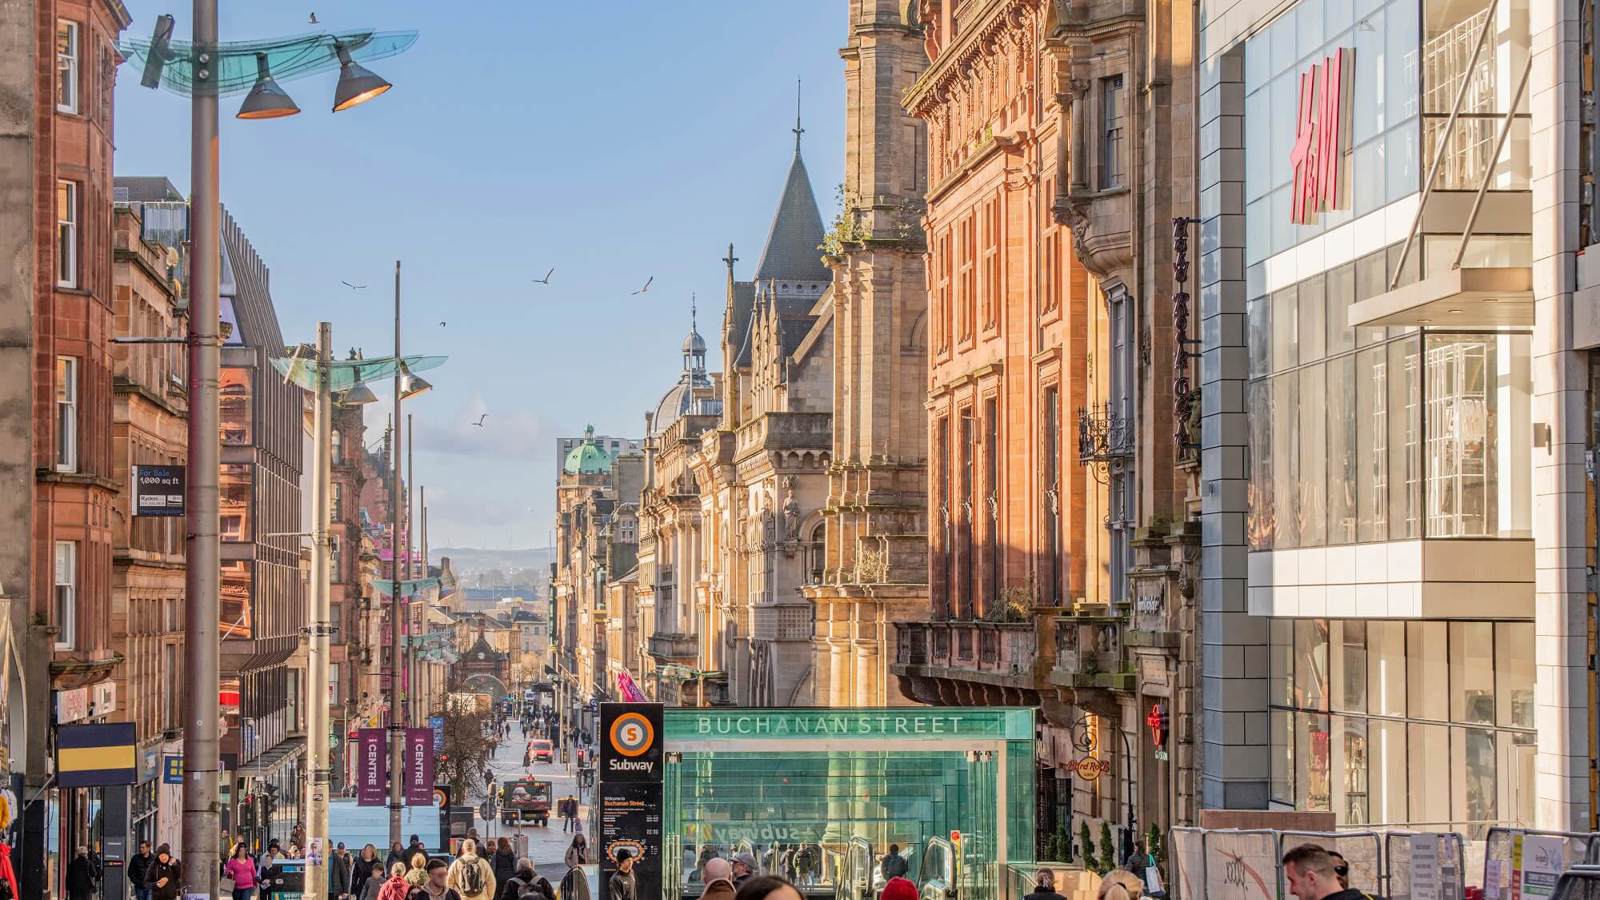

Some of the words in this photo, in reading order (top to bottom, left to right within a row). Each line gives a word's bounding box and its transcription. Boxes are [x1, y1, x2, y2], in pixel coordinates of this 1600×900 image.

[699, 717, 848, 733] BUCHANAN
[858, 717, 963, 733] STREET
[609, 758, 654, 773] Subway
[1066, 760, 1089, 772] Hard
